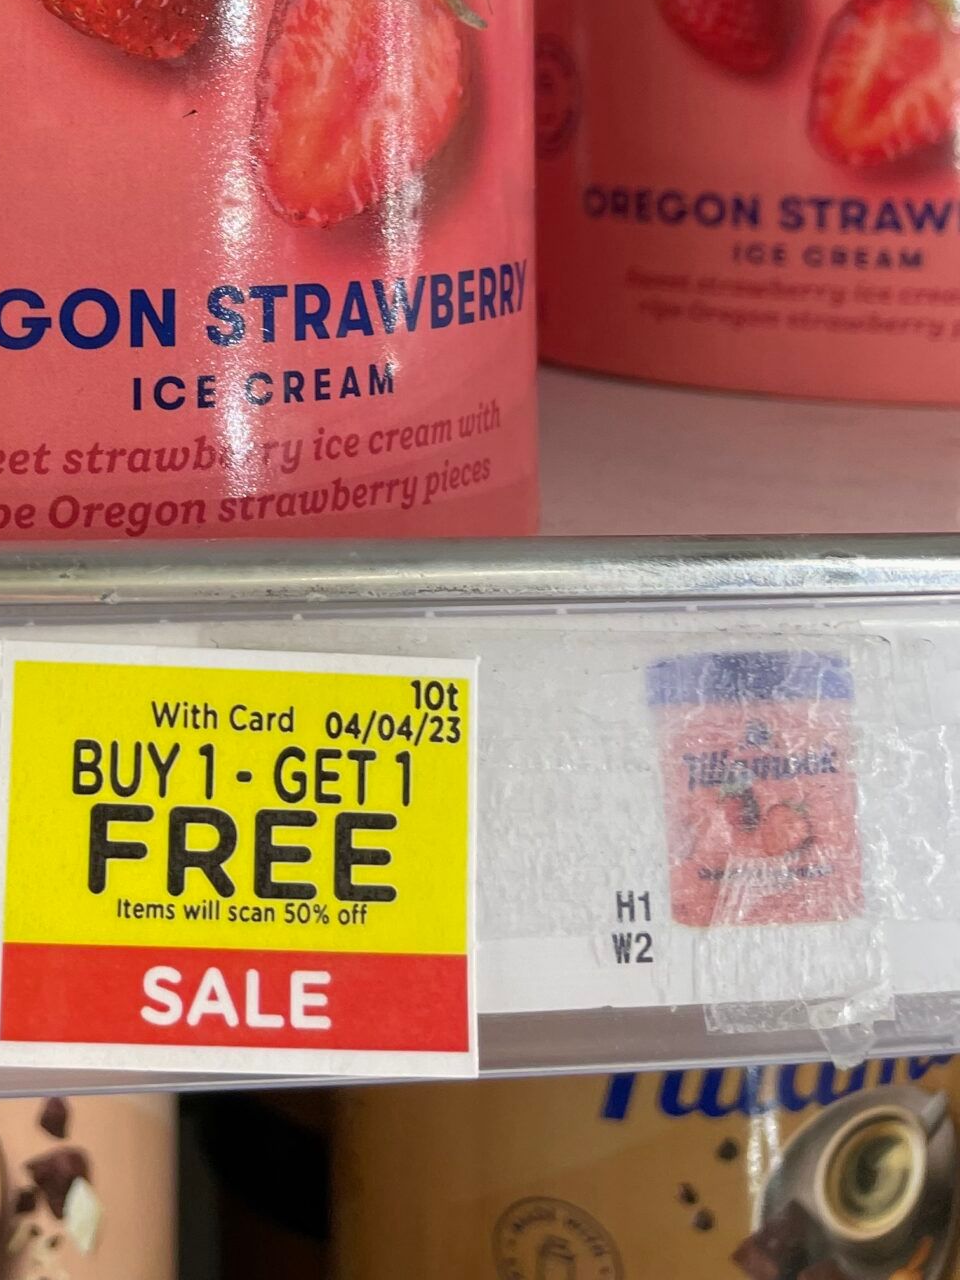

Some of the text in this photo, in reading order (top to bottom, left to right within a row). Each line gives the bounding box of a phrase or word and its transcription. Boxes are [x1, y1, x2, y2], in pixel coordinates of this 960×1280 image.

[582, 184, 960, 234] OREGON STRAW
[732, 239, 925, 270] ICE CREAM
[205, 259, 528, 348] STRAWBERRY
[132, 362, 395, 412] ICE CREAM
[312, 426, 360, 462] ice
[368, 418, 453, 456] cream
[458, 398, 503, 439] with
[47, 494, 208, 538] Oregon
[217, 473, 419, 525] strawberry
[421, 457, 492, 506] pieces
[410, 679, 459, 712] 10t
[151, 701, 462, 747] With Card 04/04/23
[71, 738, 181, 799] BUY
[198, 742, 215, 801] 1
[273, 745, 377, 806] GET
[394, 750, 411, 807] 1
[87, 802, 398, 903] FREE
[116, 898, 369, 926] Items will scan 50% off
[615, 889, 653, 923] H1
[611, 931, 654, 965] W2
[139, 965, 333, 1031] SALE
